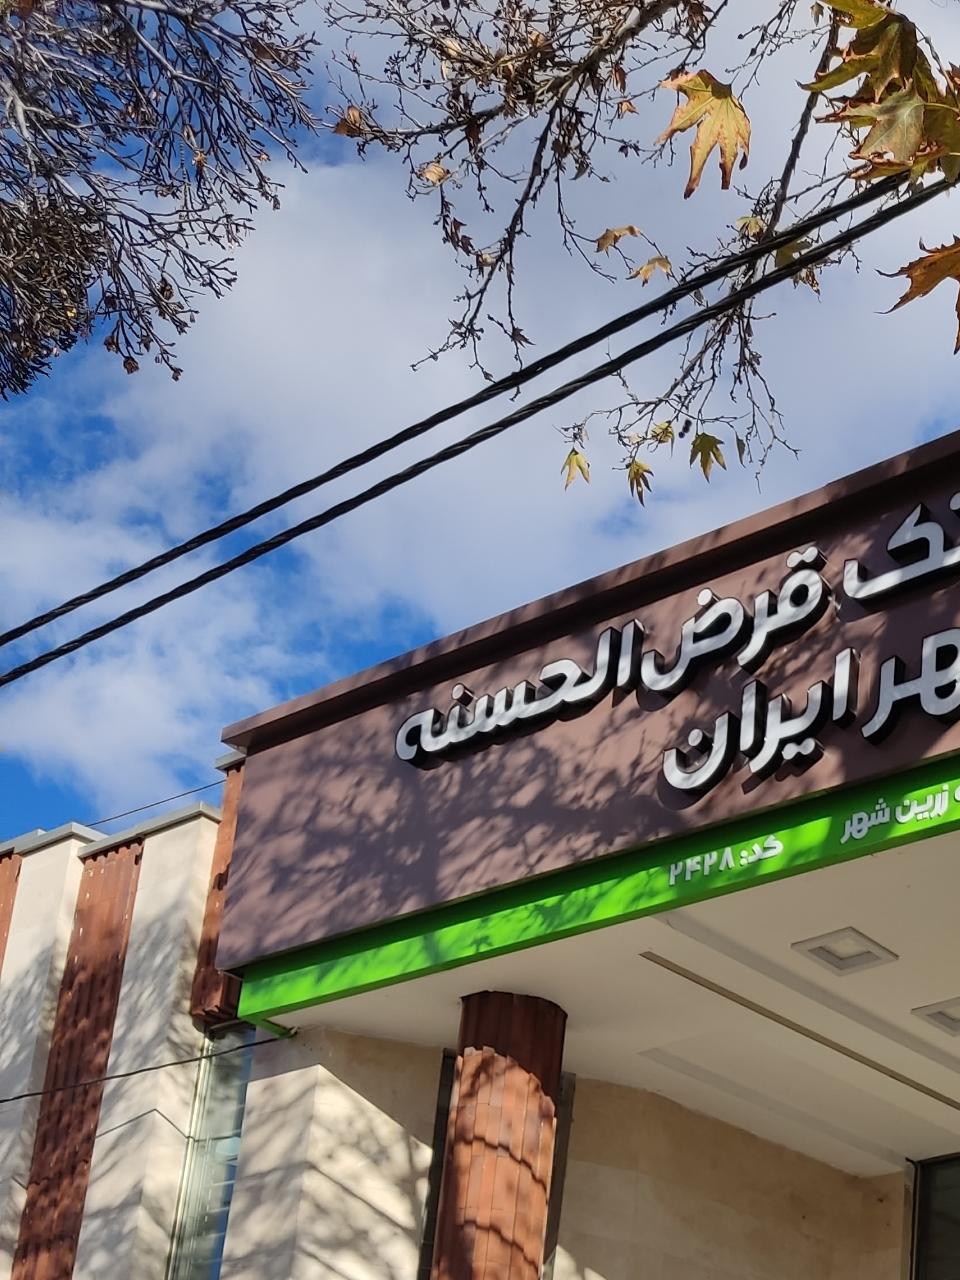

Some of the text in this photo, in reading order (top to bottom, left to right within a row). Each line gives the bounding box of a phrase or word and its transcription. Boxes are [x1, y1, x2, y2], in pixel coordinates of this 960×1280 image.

[641, 546, 824, 691] قرض
[396, 619, 643, 761] الحسنه
[663, 647, 853, 790] ایران
[840, 797, 891, 844] شهر
[895, 783, 950, 824] زرین
[668, 846, 734, 886] ۲۴۲۸
